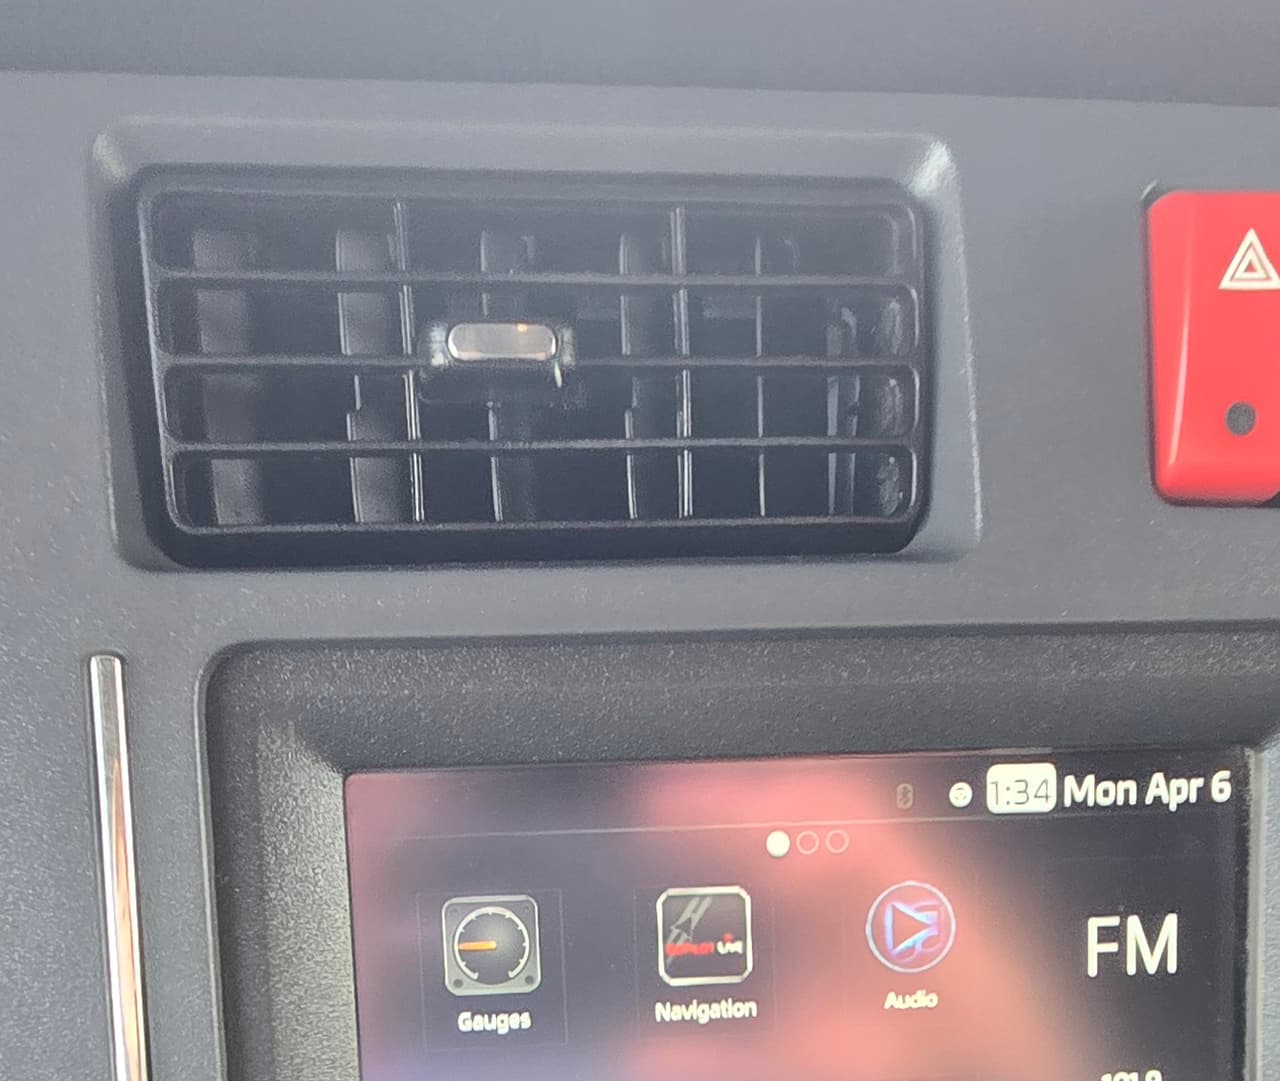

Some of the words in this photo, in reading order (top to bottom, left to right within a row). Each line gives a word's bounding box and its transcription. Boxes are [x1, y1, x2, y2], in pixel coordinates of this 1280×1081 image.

[990, 778, 1053, 807] 1:34
[1063, 773, 1137, 808] Mon
[1145, 771, 1204, 812] Apr
[1211, 769, 1232, 803] 6
[1086, 912, 1179, 978] FM
[654, 998, 758, 1025] Navigation
[883, 989, 939, 1010] Audio
[457, 1011, 532, 1035] Gauges
